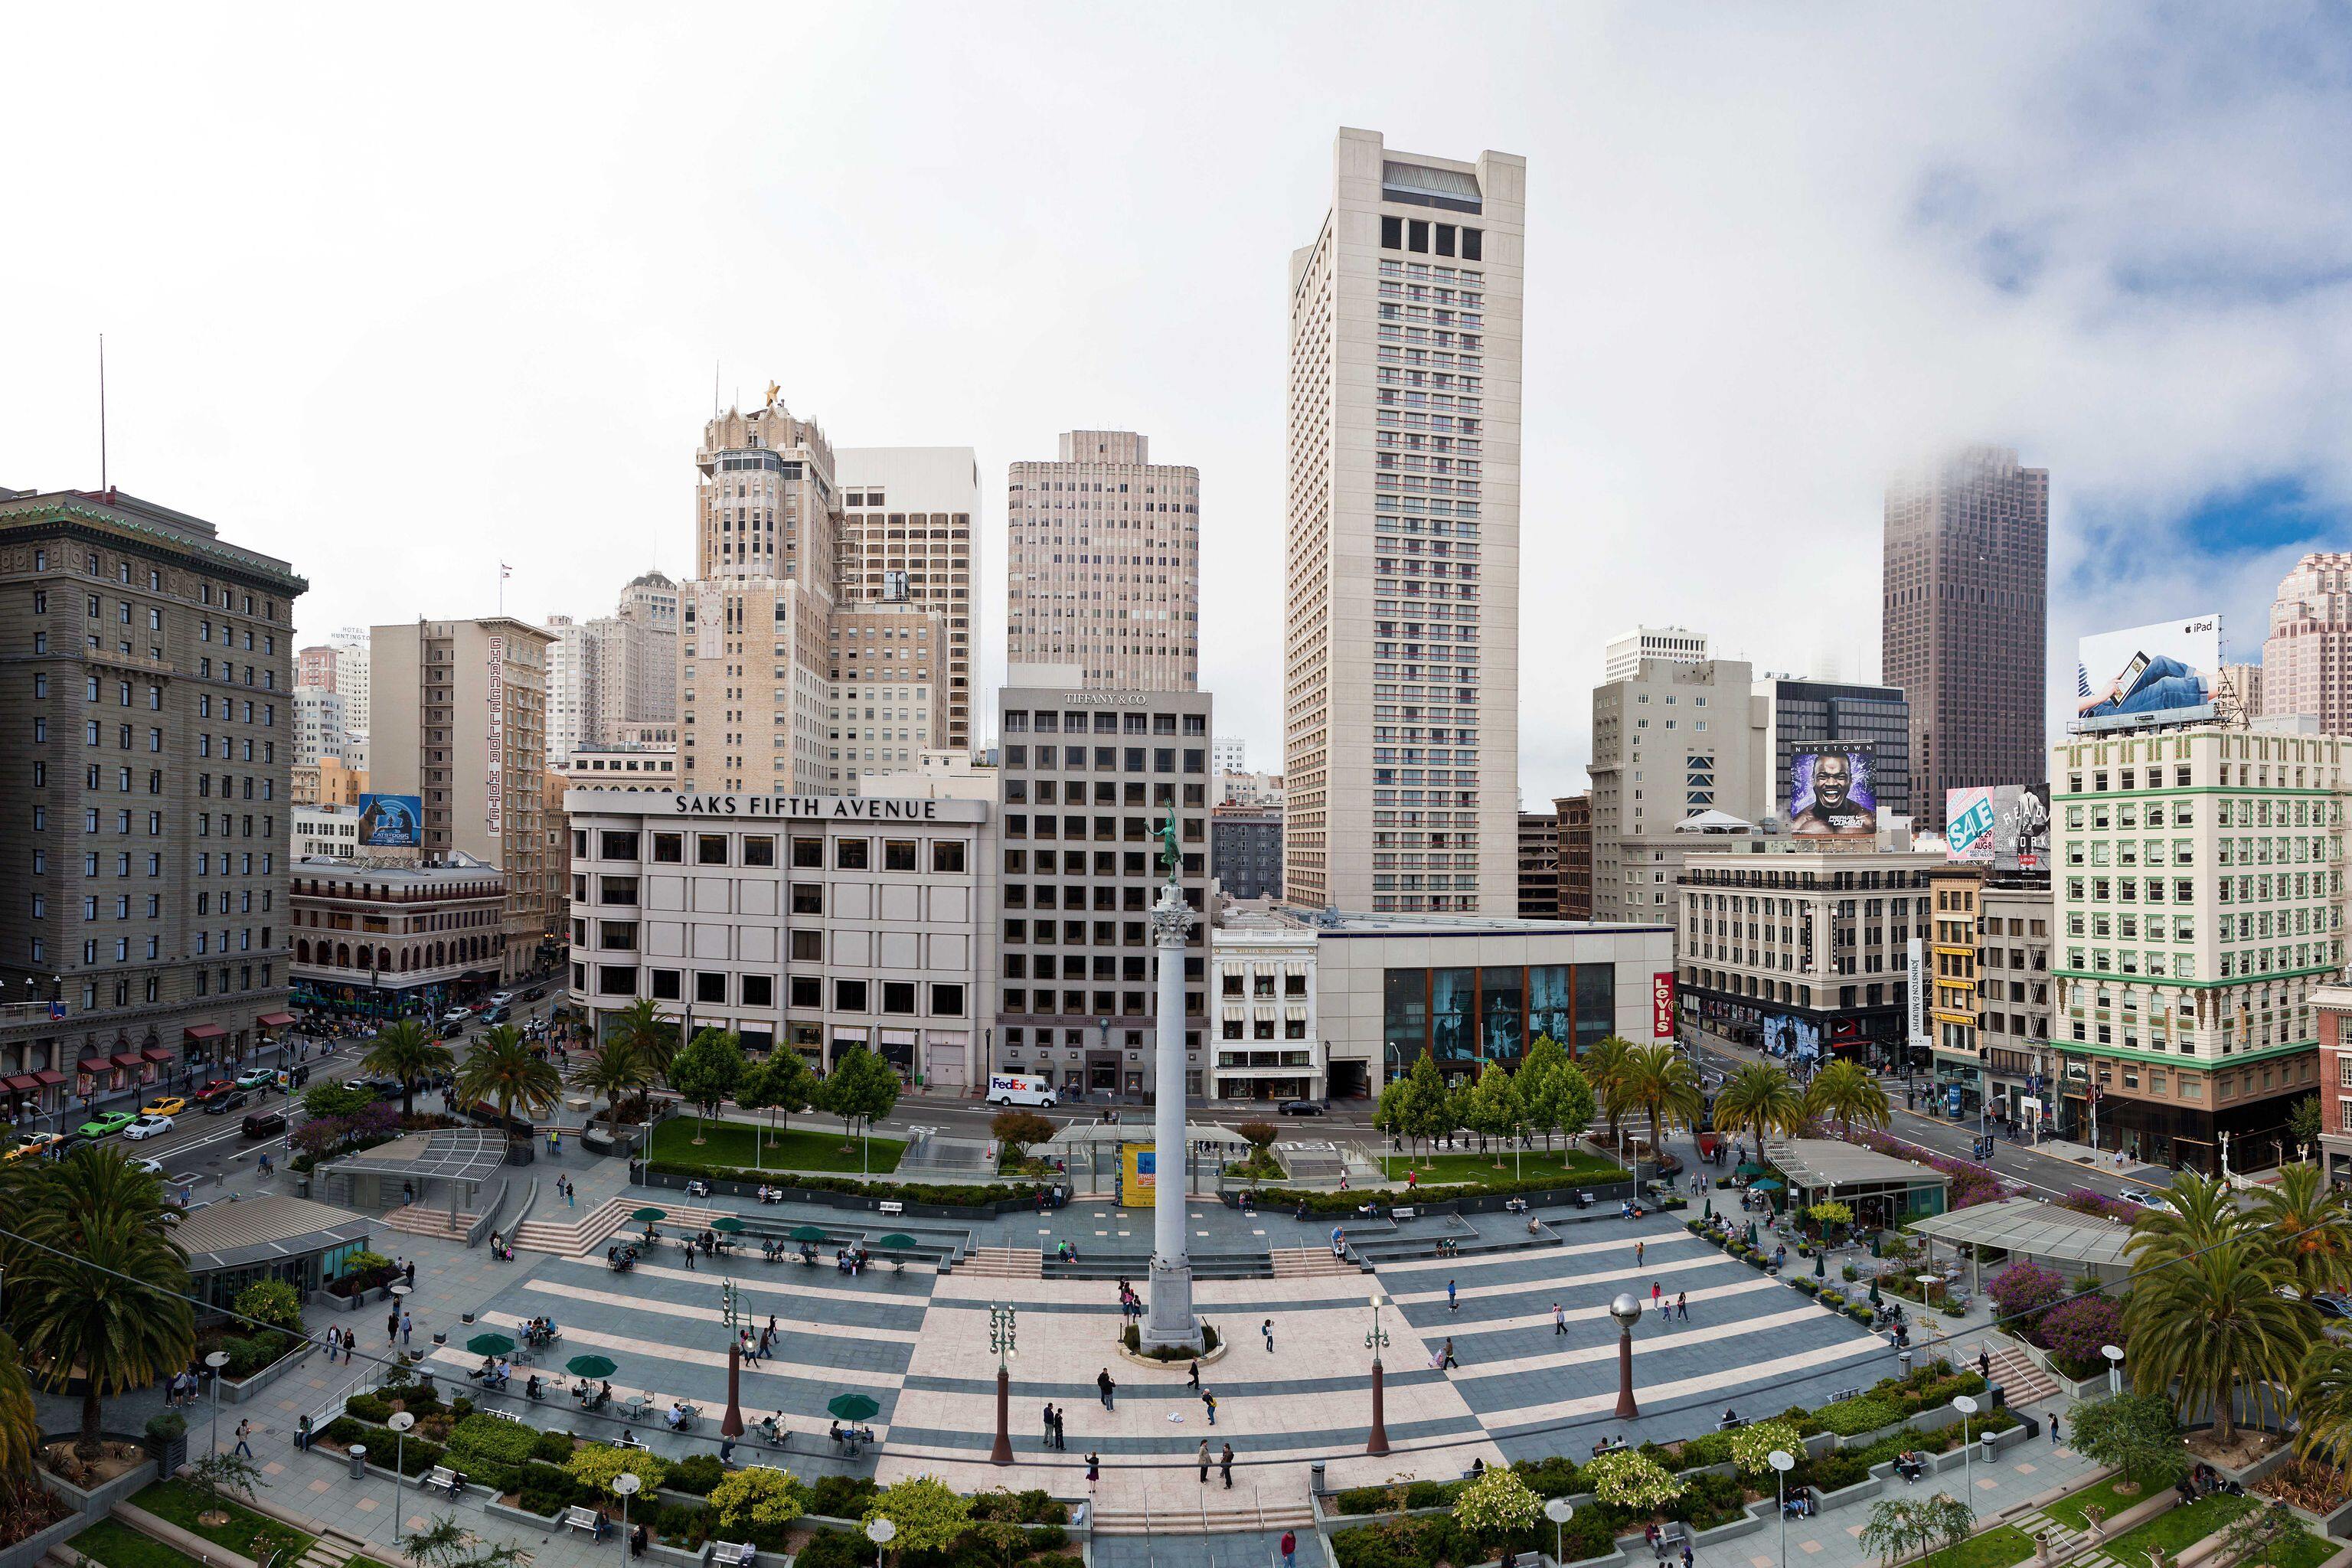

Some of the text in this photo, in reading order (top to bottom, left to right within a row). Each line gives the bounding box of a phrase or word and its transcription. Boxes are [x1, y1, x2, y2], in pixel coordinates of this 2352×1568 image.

[2194, 621, 2212, 632] iPad
[1064, 694, 1148, 706] TIFFANY & CO.
[488, 638, 501, 832] CHANCELLOR HOTEL
[677, 795, 936, 818] SAKS FIFTH AVENUE
[2003, 805, 2051, 825] READ
[1950, 800, 1993, 848] SALE
[1984, 830, 1992, 838] 29
[2008, 836, 2047, 848] WORK
[1910, 959, 1919, 995] JOHNSTON
[23, 1067, 43, 1075] SECRET
[992, 1077, 1027, 1091] FedEx
